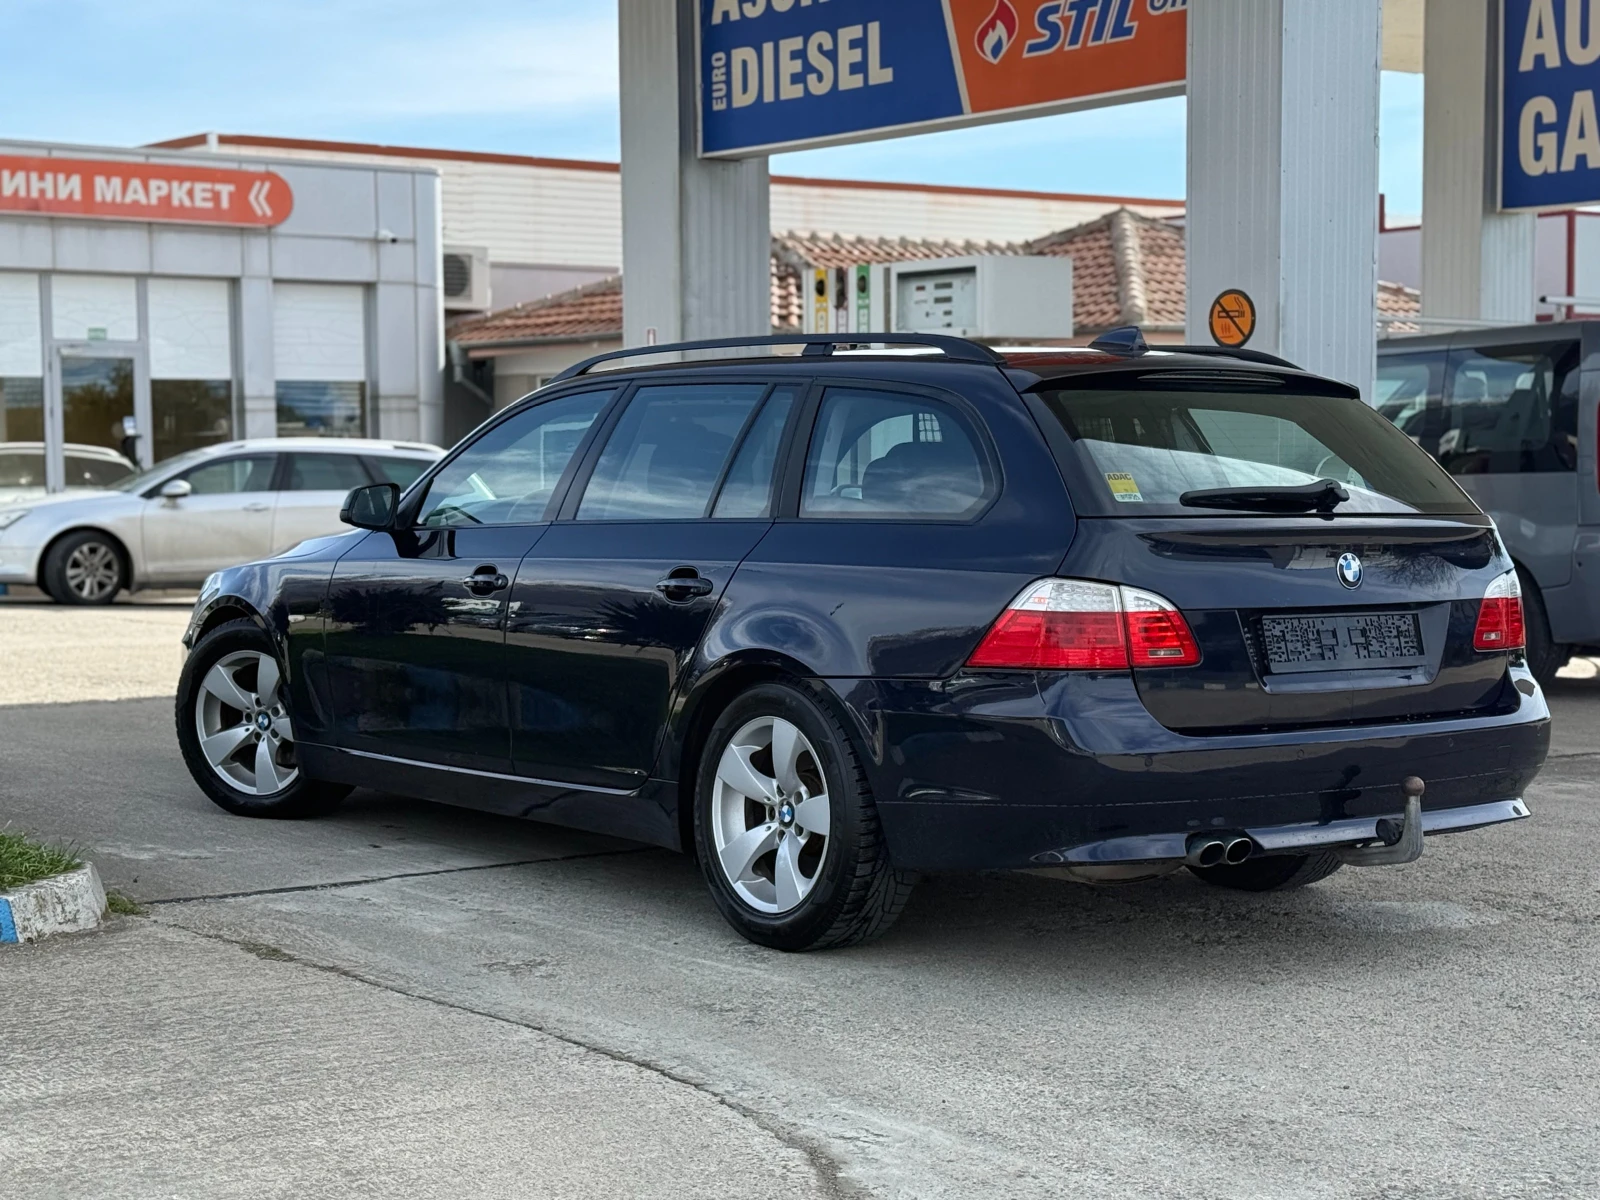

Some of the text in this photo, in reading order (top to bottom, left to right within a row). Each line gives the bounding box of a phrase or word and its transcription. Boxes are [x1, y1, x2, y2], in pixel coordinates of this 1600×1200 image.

[1022, 0, 1139, 58] STIL
[711, 51, 727, 112] EURO
[731, 20, 894, 109] DIESEL
[1, 168, 236, 210] ИНИ МАРКЕТ
[1107, 473, 1132, 481] ADAC
